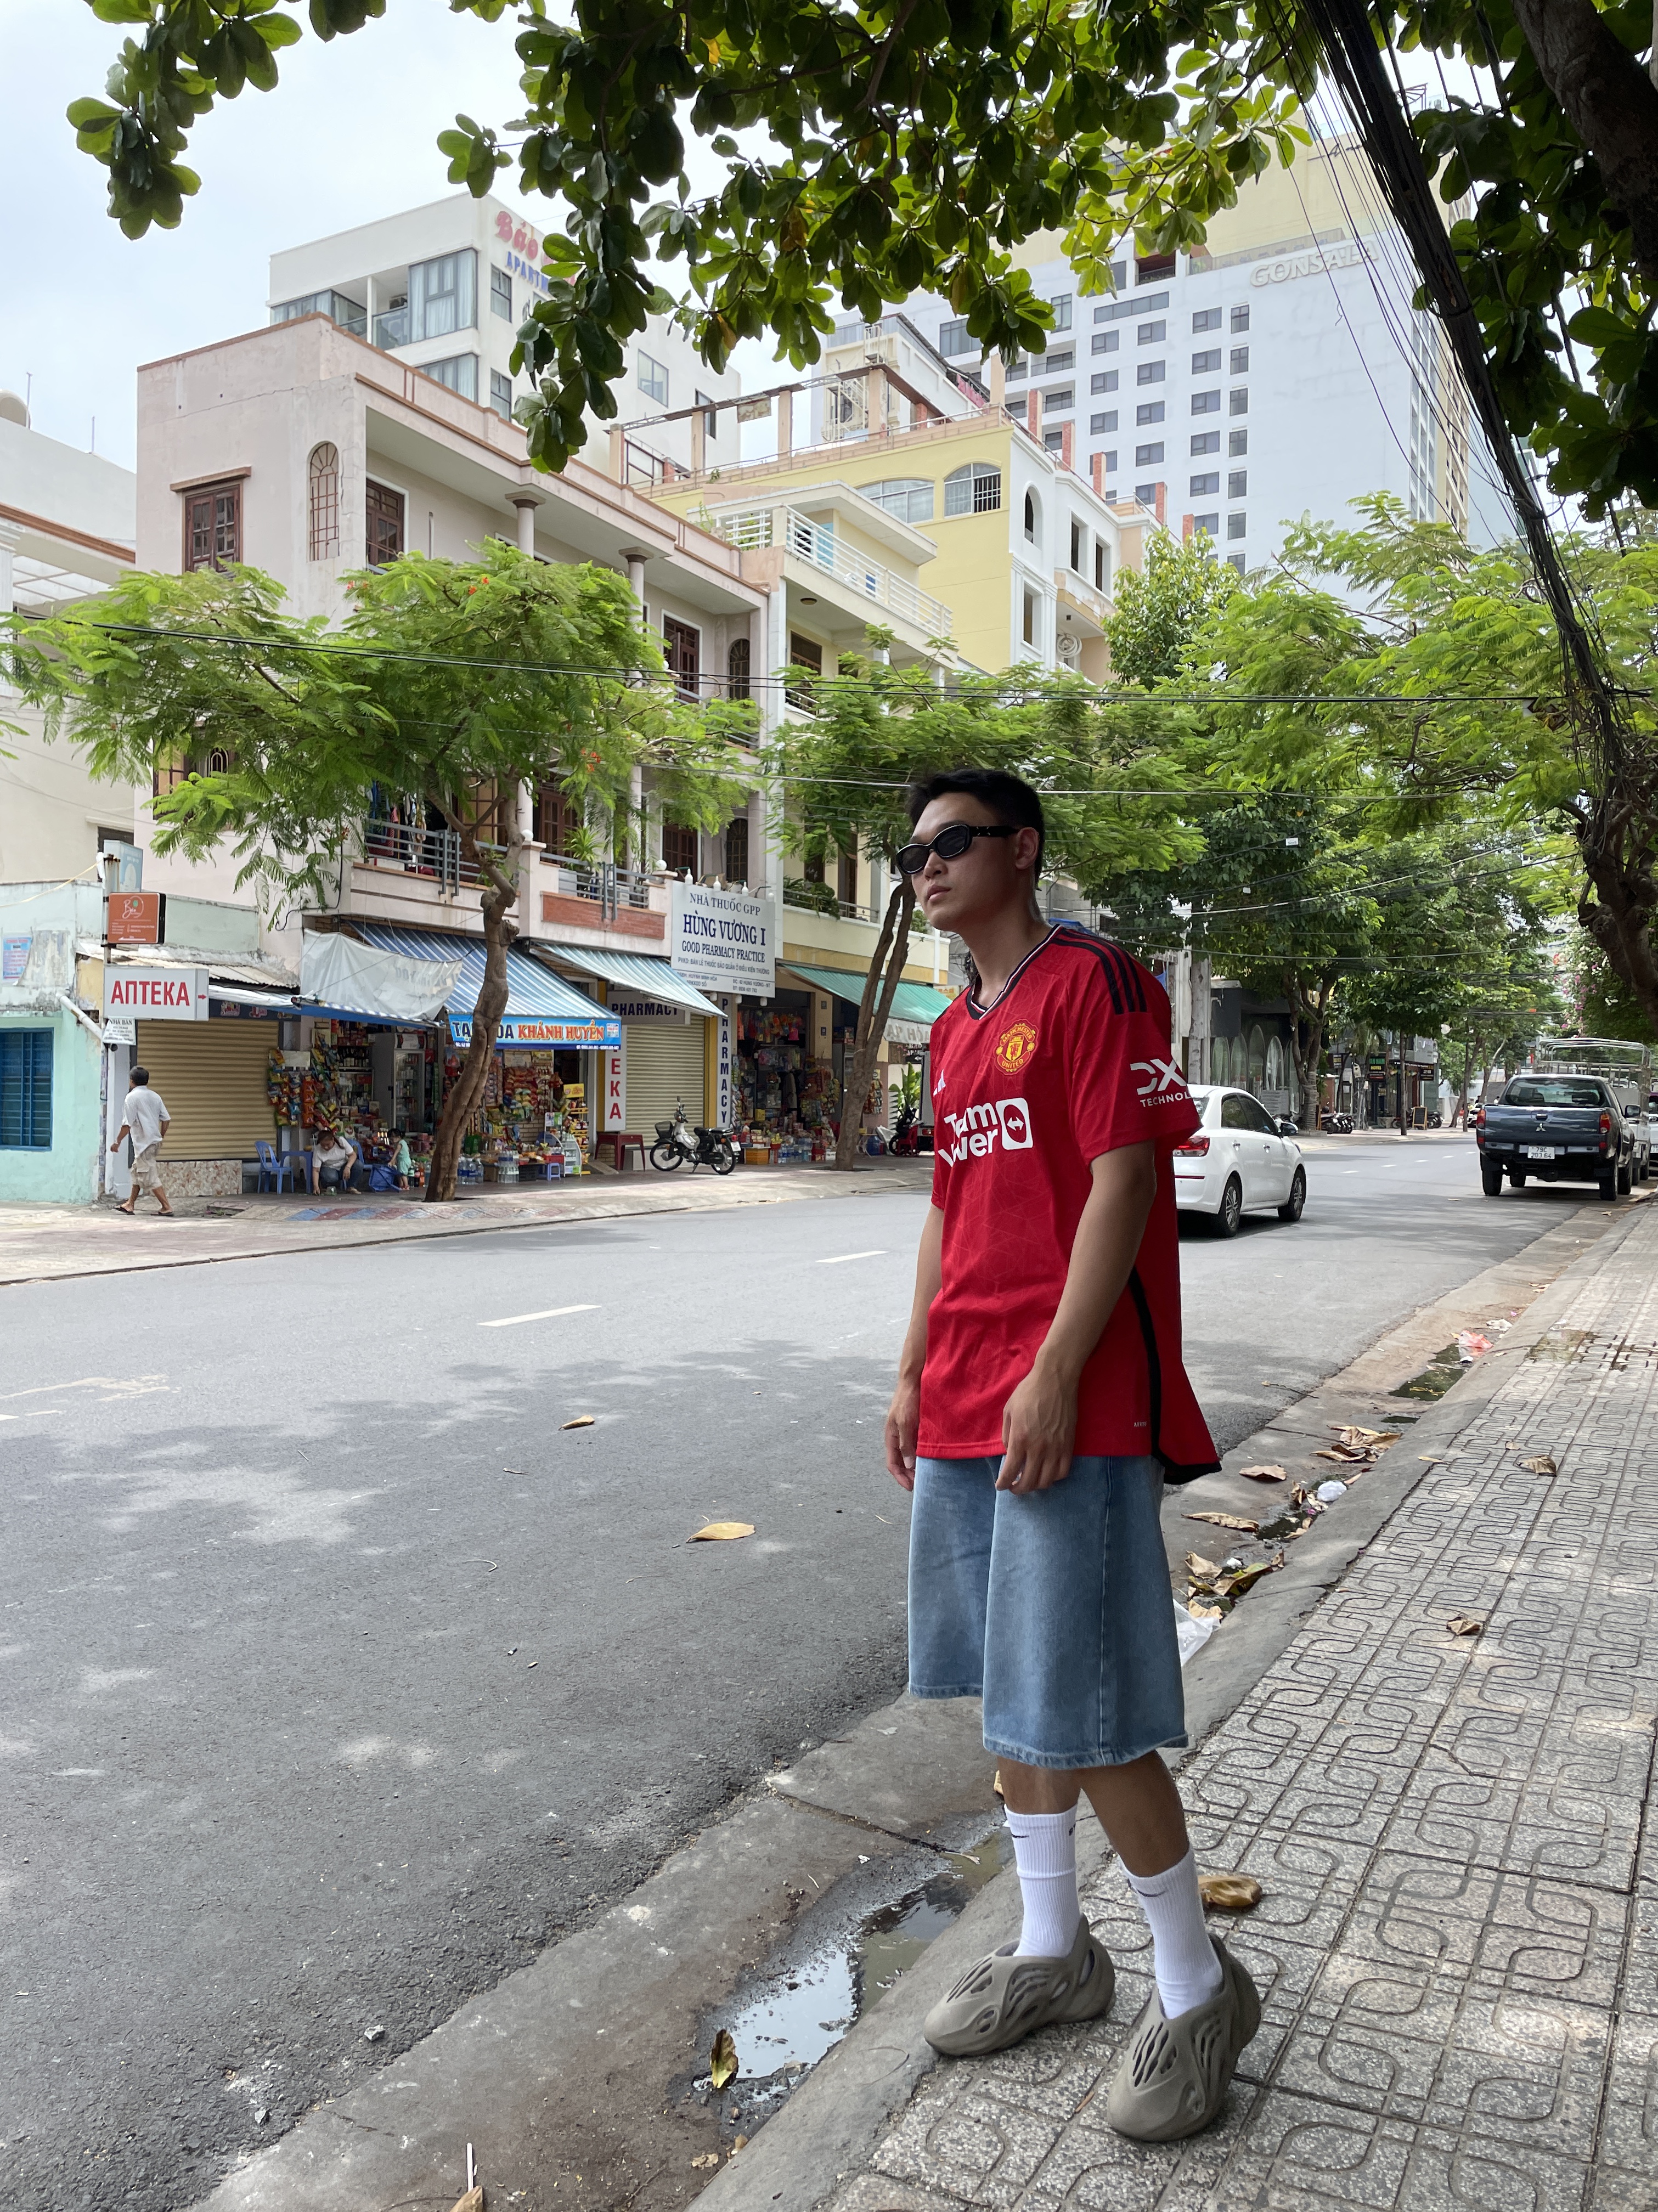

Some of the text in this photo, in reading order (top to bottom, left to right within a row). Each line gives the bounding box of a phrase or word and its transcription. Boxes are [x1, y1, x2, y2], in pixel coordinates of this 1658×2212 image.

[506, 251, 549, 294] APARTM
[690, 893, 760, 916] NHÀ THUỐC GPP
[683, 910, 717, 938] HÙNG
[719, 919, 757, 945] VƯƠNG
[682, 940, 765, 963] GOOD PHARMACY PRACTICE
[111, 980, 190, 1006] АПТЕКА
[1002, 1026, 1033, 1042] MANCHESTER
[1001, 1058, 1023, 1068] UNITED
[1140, 1091, 1191, 1107] TECHNOL
